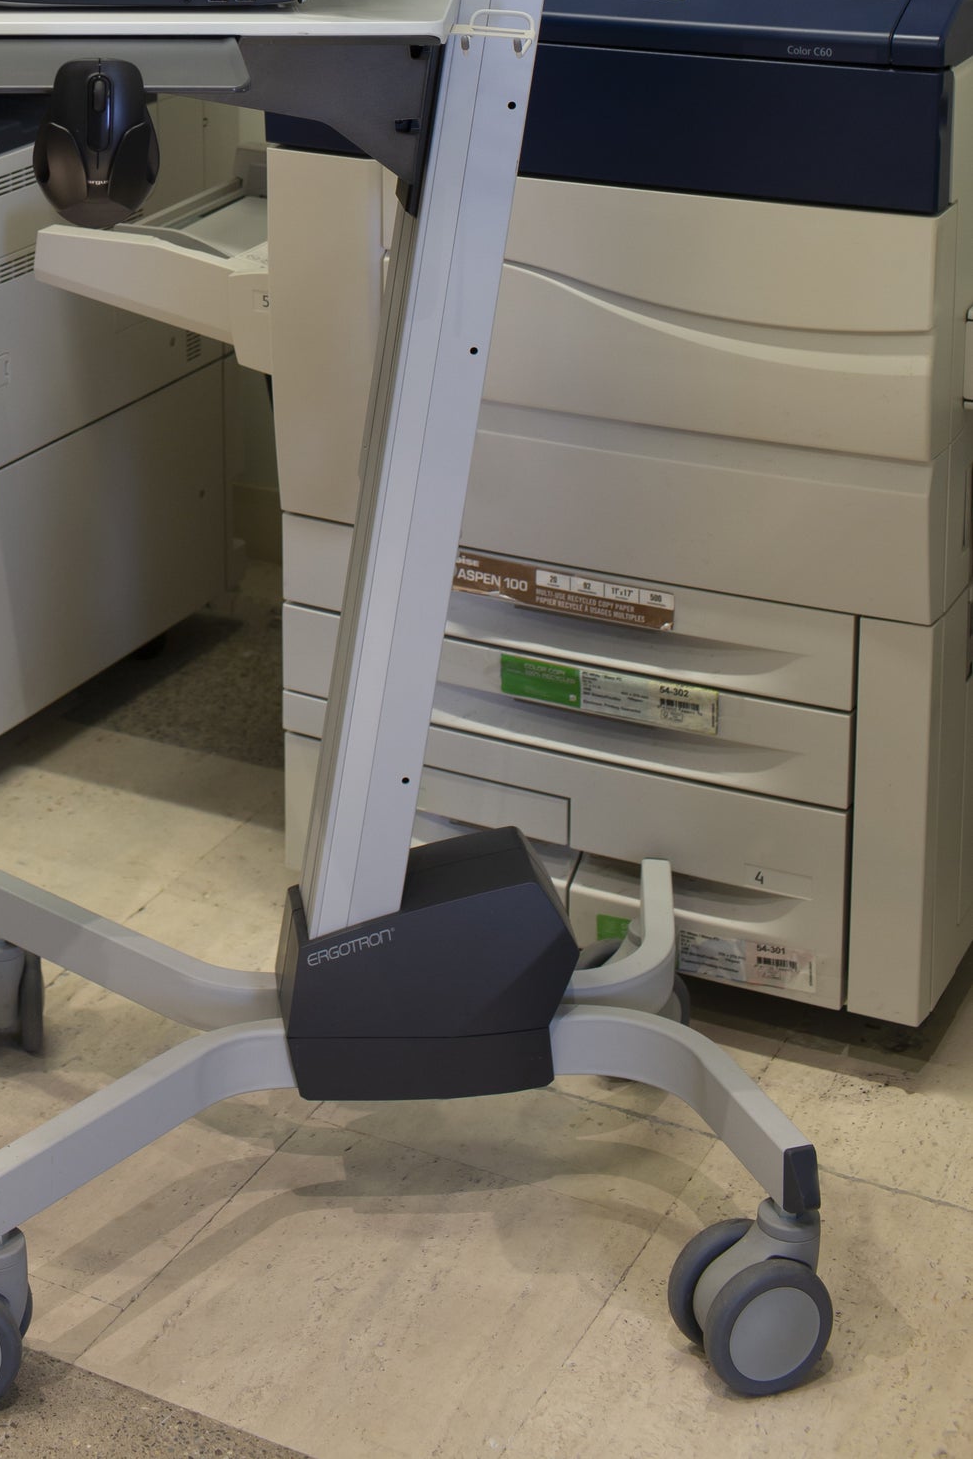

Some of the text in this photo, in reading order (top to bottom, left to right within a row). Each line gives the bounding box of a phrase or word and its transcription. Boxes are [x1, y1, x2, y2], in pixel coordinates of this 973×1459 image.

[787, 45, 833, 58] Color C60
[262, 295, 270, 308] 5
[457, 568, 528, 592] ASPEN 100
[567, 593, 596, 607] RECYCLED
[598, 599, 614, 609] COPY
[615, 602, 635, 613] PAPER
[659, 685, 690, 698] 54-302
[754, 870, 764, 885] 4
[307, 928, 392, 967] ERGOTRON
[756, 943, 786, 955] 54-301
